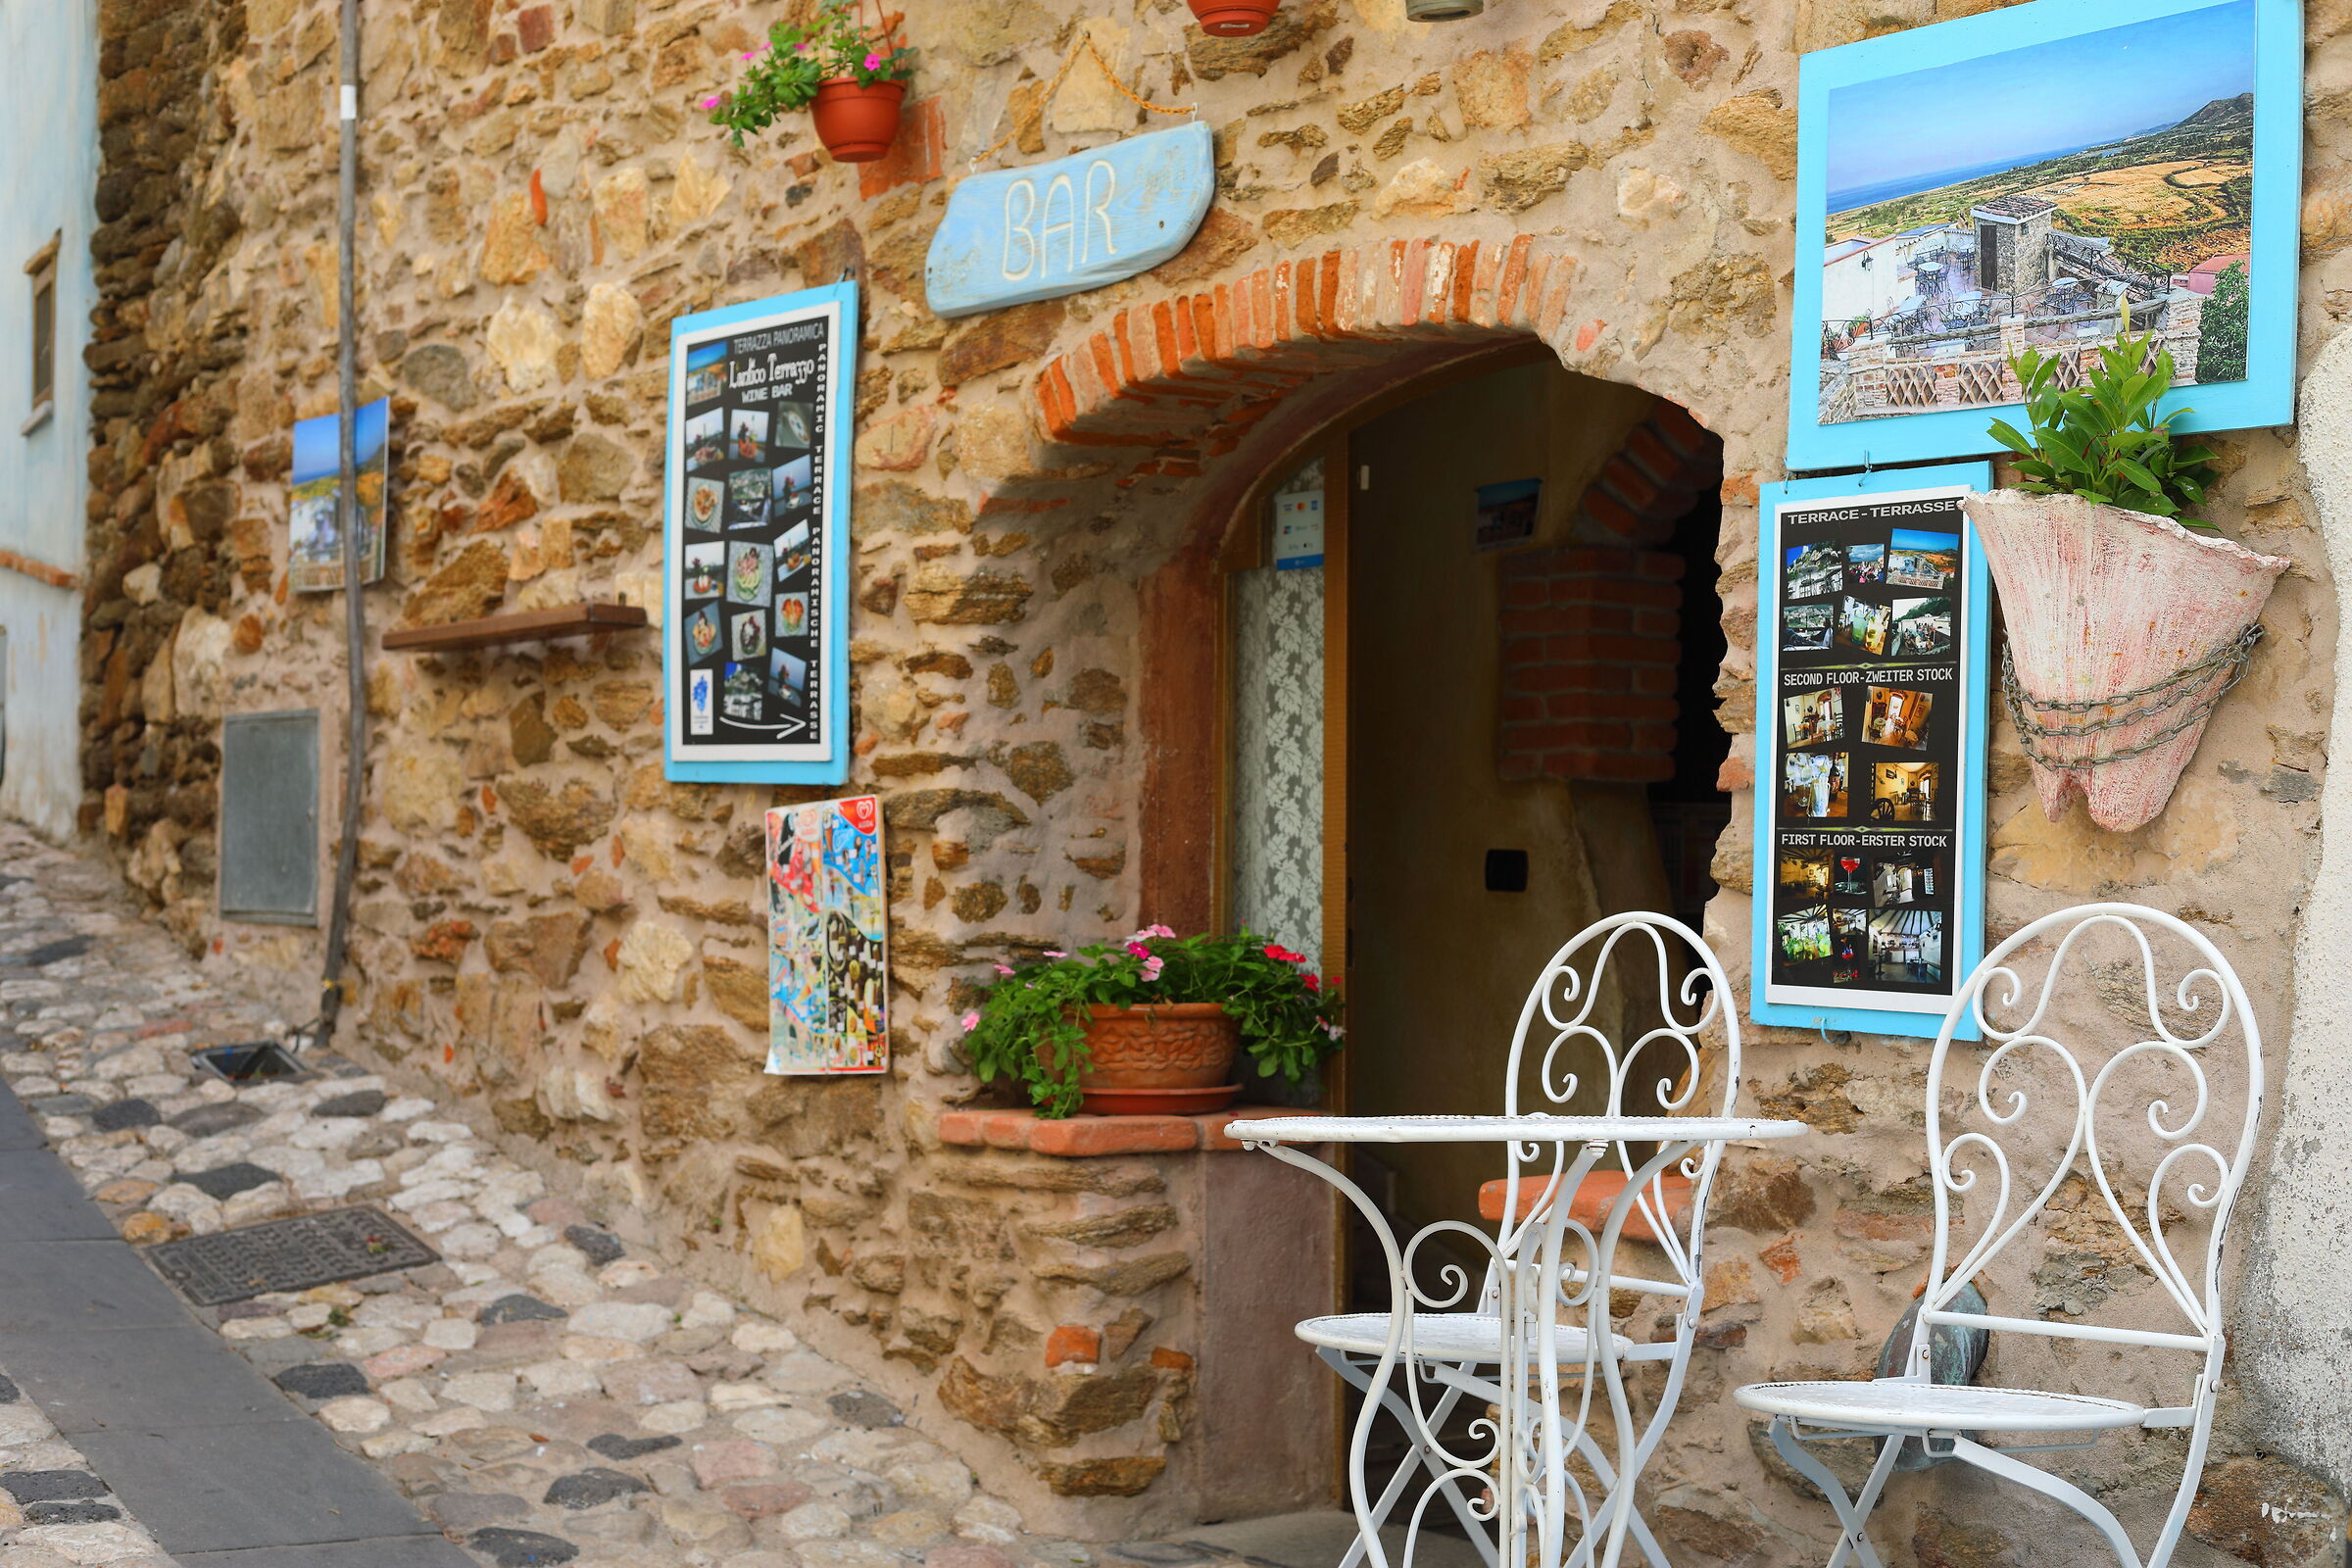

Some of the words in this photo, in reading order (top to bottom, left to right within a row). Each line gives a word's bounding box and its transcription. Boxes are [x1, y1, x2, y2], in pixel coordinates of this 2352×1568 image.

[1001, 158, 1118, 282] BAR
[733, 332, 772, 354] TERRAZZA
[772, 321, 824, 346] PANORAMICA
[741, 386, 768, 404] WINE
[771, 382, 793, 399] BAR
[814, 343, 827, 433] PANORAMIC
[812, 445, 823, 515] TERRACE
[1788, 509, 1860, 525] TERRACE
[1870, 500, 1956, 519] TERRASSE
[810, 527, 821, 648] PANORAMISCHE
[809, 660, 818, 740] TERRASSE
[1784, 672, 1823, 686] SECOND
[1916, 667, 1953, 682] STOCK
[1782, 833, 1816, 846] FIRST
[1909, 835, 1947, 848] STOCK
